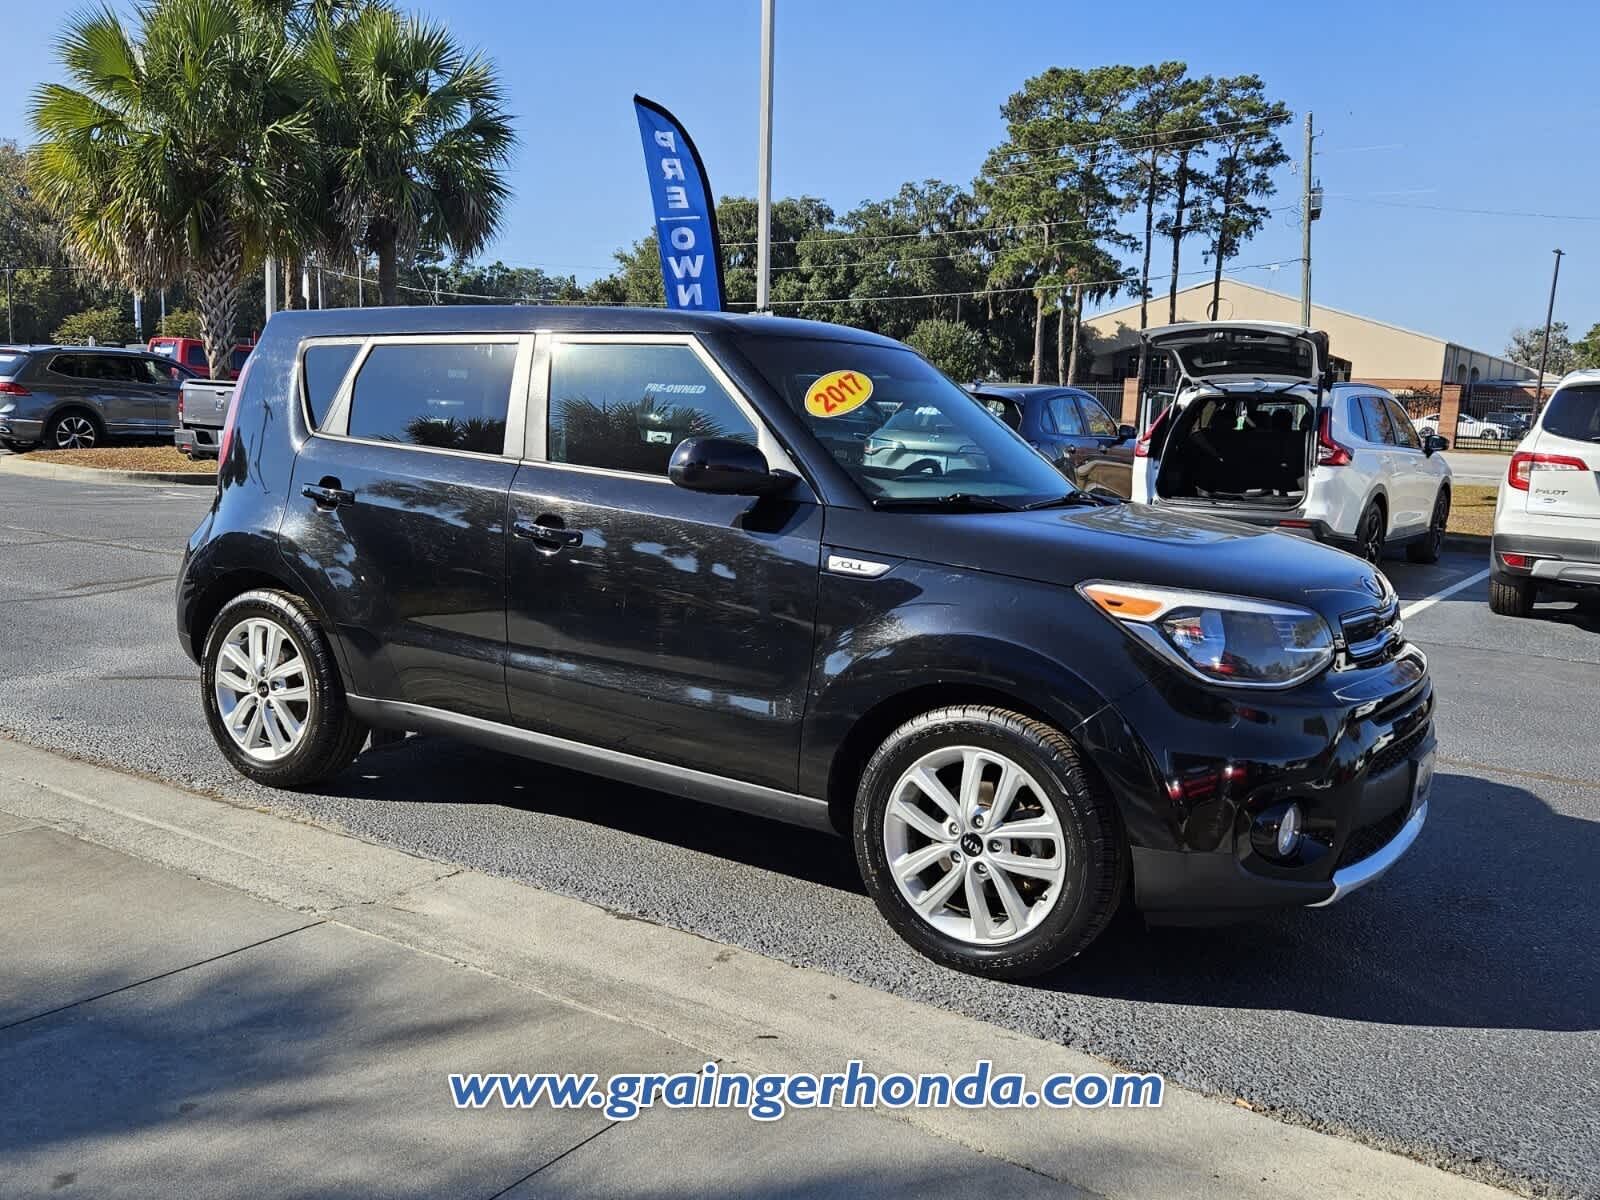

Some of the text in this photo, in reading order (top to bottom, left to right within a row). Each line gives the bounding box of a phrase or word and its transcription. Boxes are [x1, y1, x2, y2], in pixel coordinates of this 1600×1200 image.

[645, 383, 706, 394] PRE-OWNED
[814, 373, 863, 412] 2017
[1535, 488, 1568, 496] PILOT
[831, 560, 868, 572] SOUL
